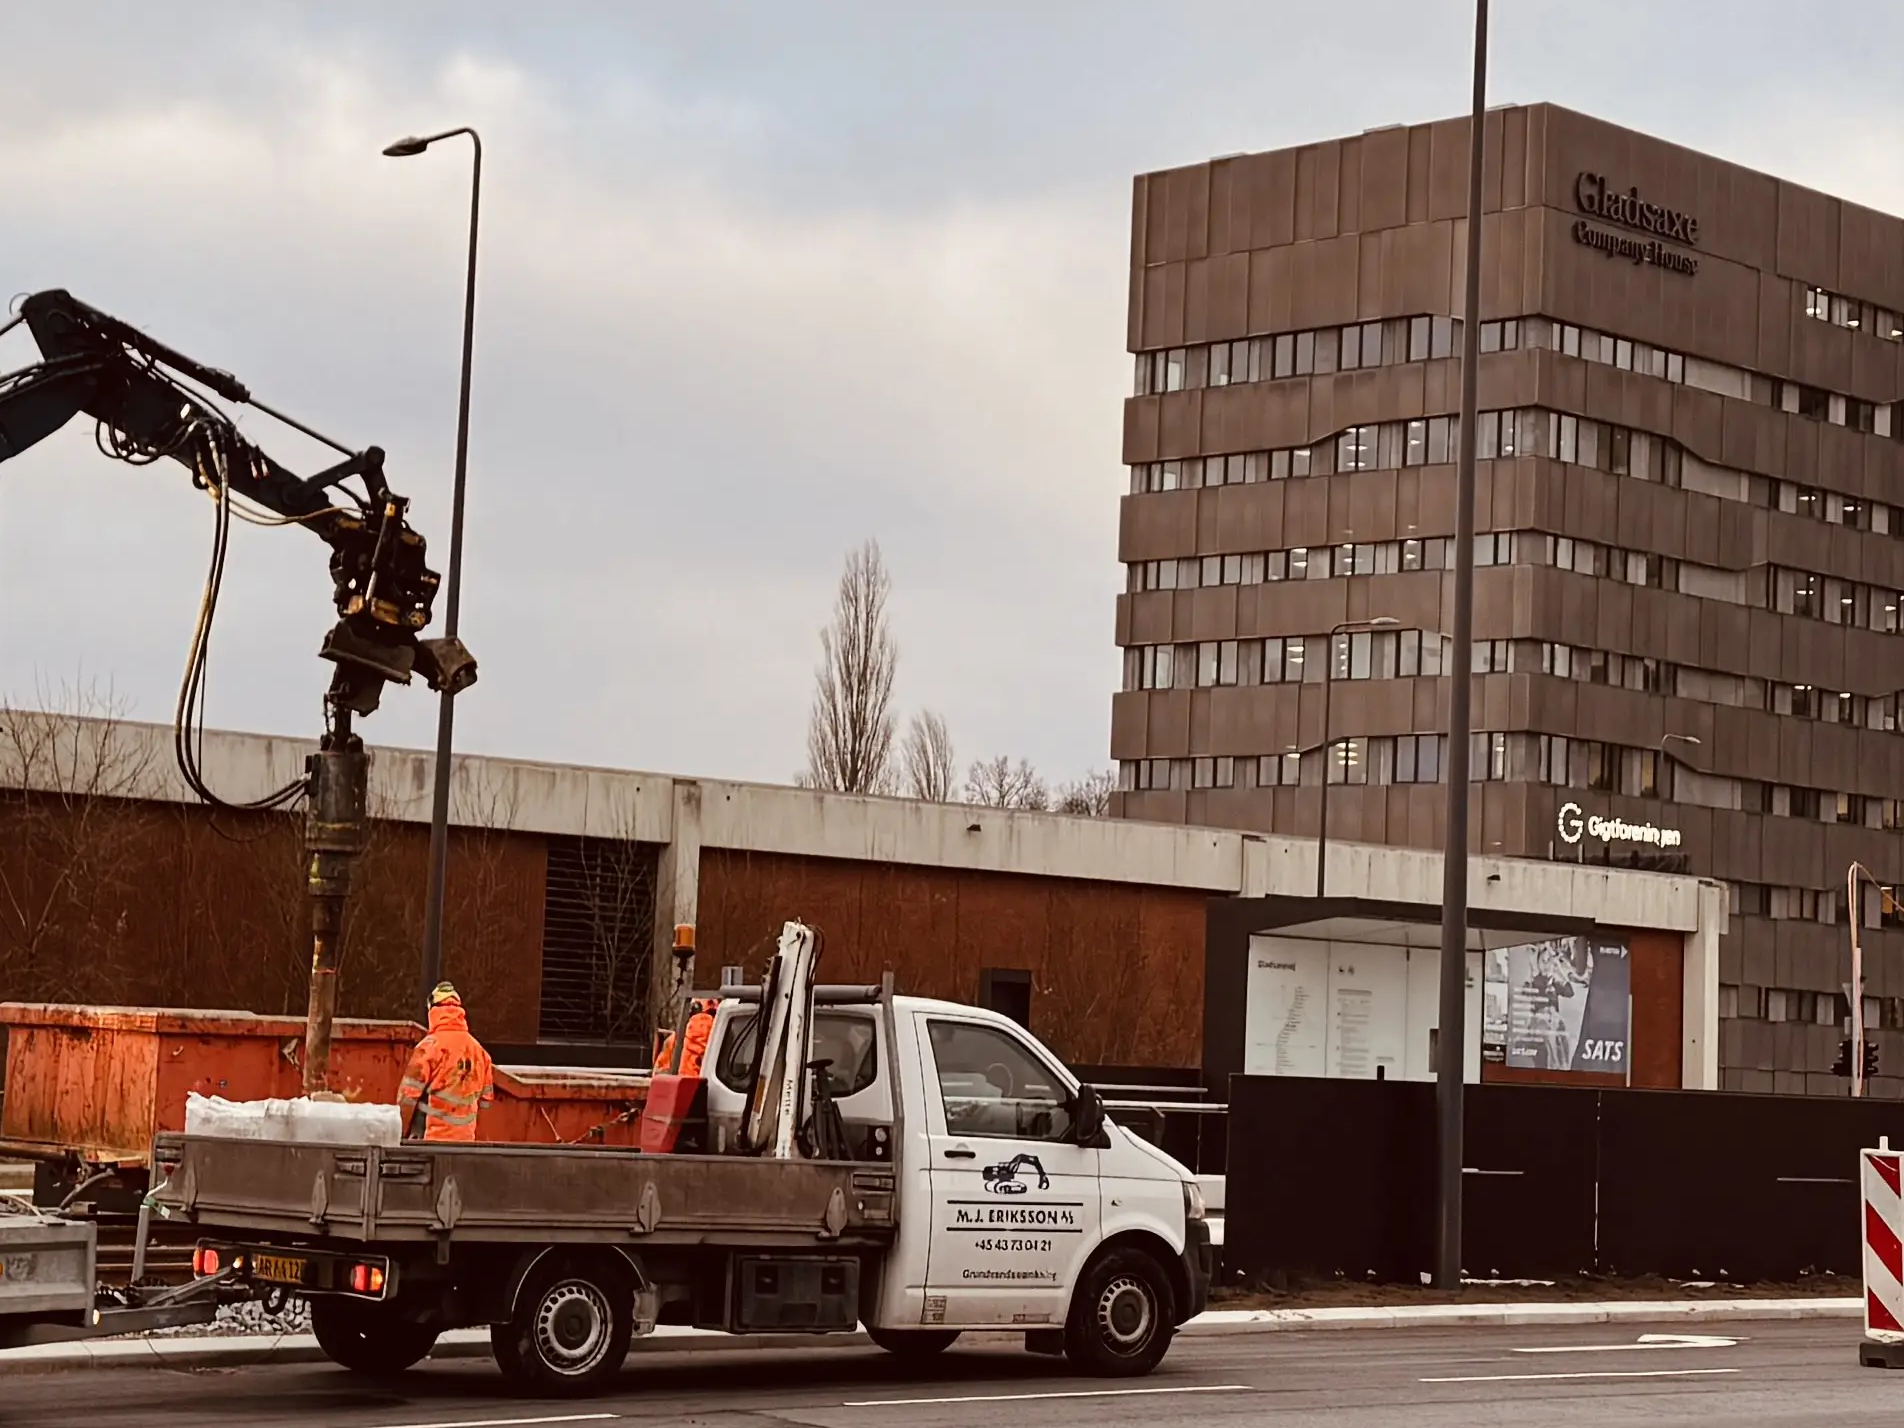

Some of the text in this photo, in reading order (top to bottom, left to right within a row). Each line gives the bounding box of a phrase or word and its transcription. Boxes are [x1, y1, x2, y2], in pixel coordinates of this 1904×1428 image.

[1573, 172, 1698, 245] Gladsaxe
[1571, 220, 1699, 276] Company House
[1582, 1039, 1624, 1062] SATS
[989, 1209, 1058, 1224] ERIKSSON
